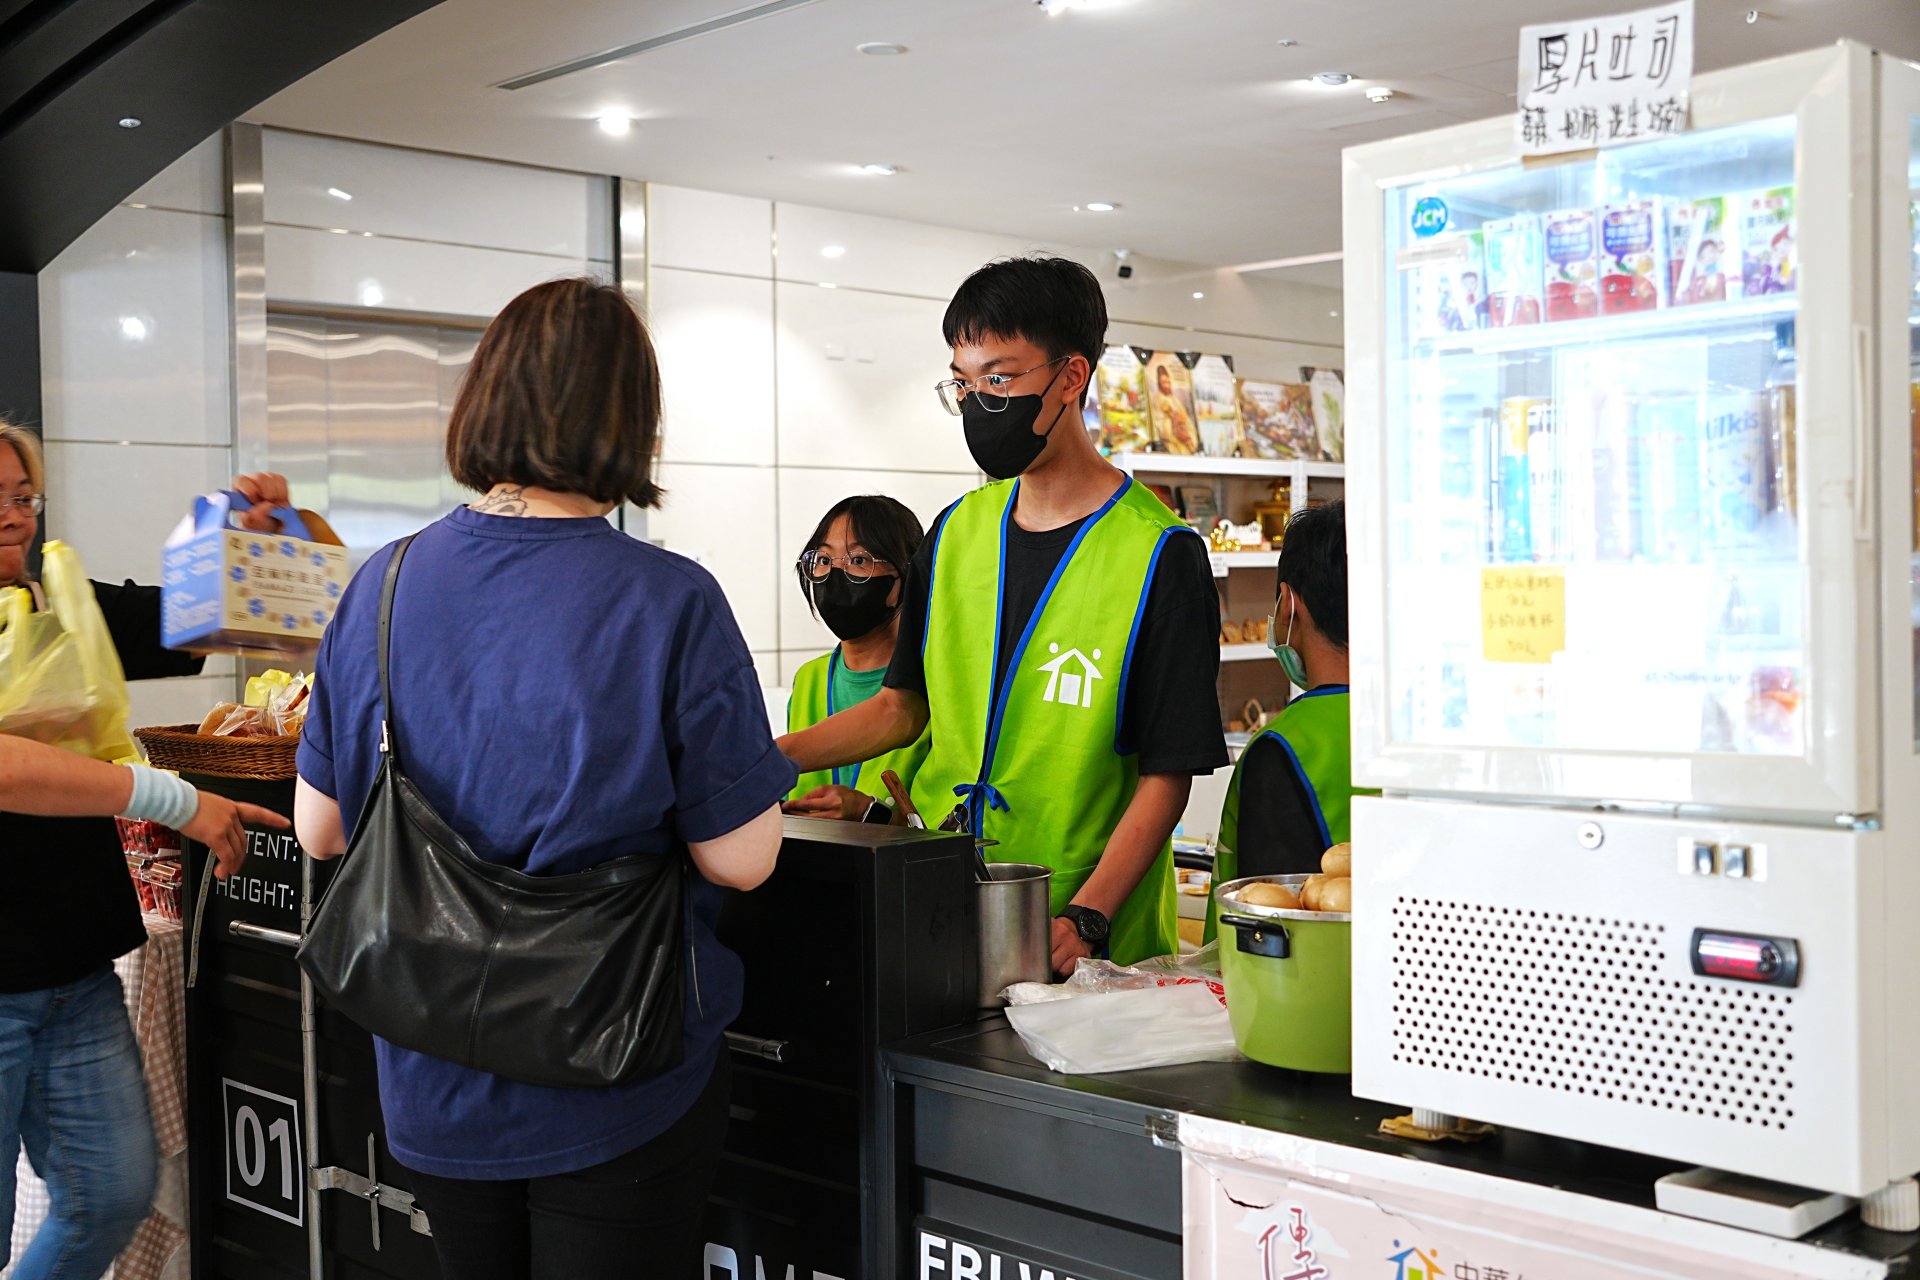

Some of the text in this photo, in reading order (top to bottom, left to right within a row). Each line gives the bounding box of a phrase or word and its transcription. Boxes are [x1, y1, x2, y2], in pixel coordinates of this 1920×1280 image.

[1533, 15, 1679, 94] 厚片吐司
[245, 830, 298, 862] TENT:
[216, 875, 295, 911] HEIGHT:
[235, 1104, 293, 1201] 01
[1454, 1261, 1528, 1280] 中華
